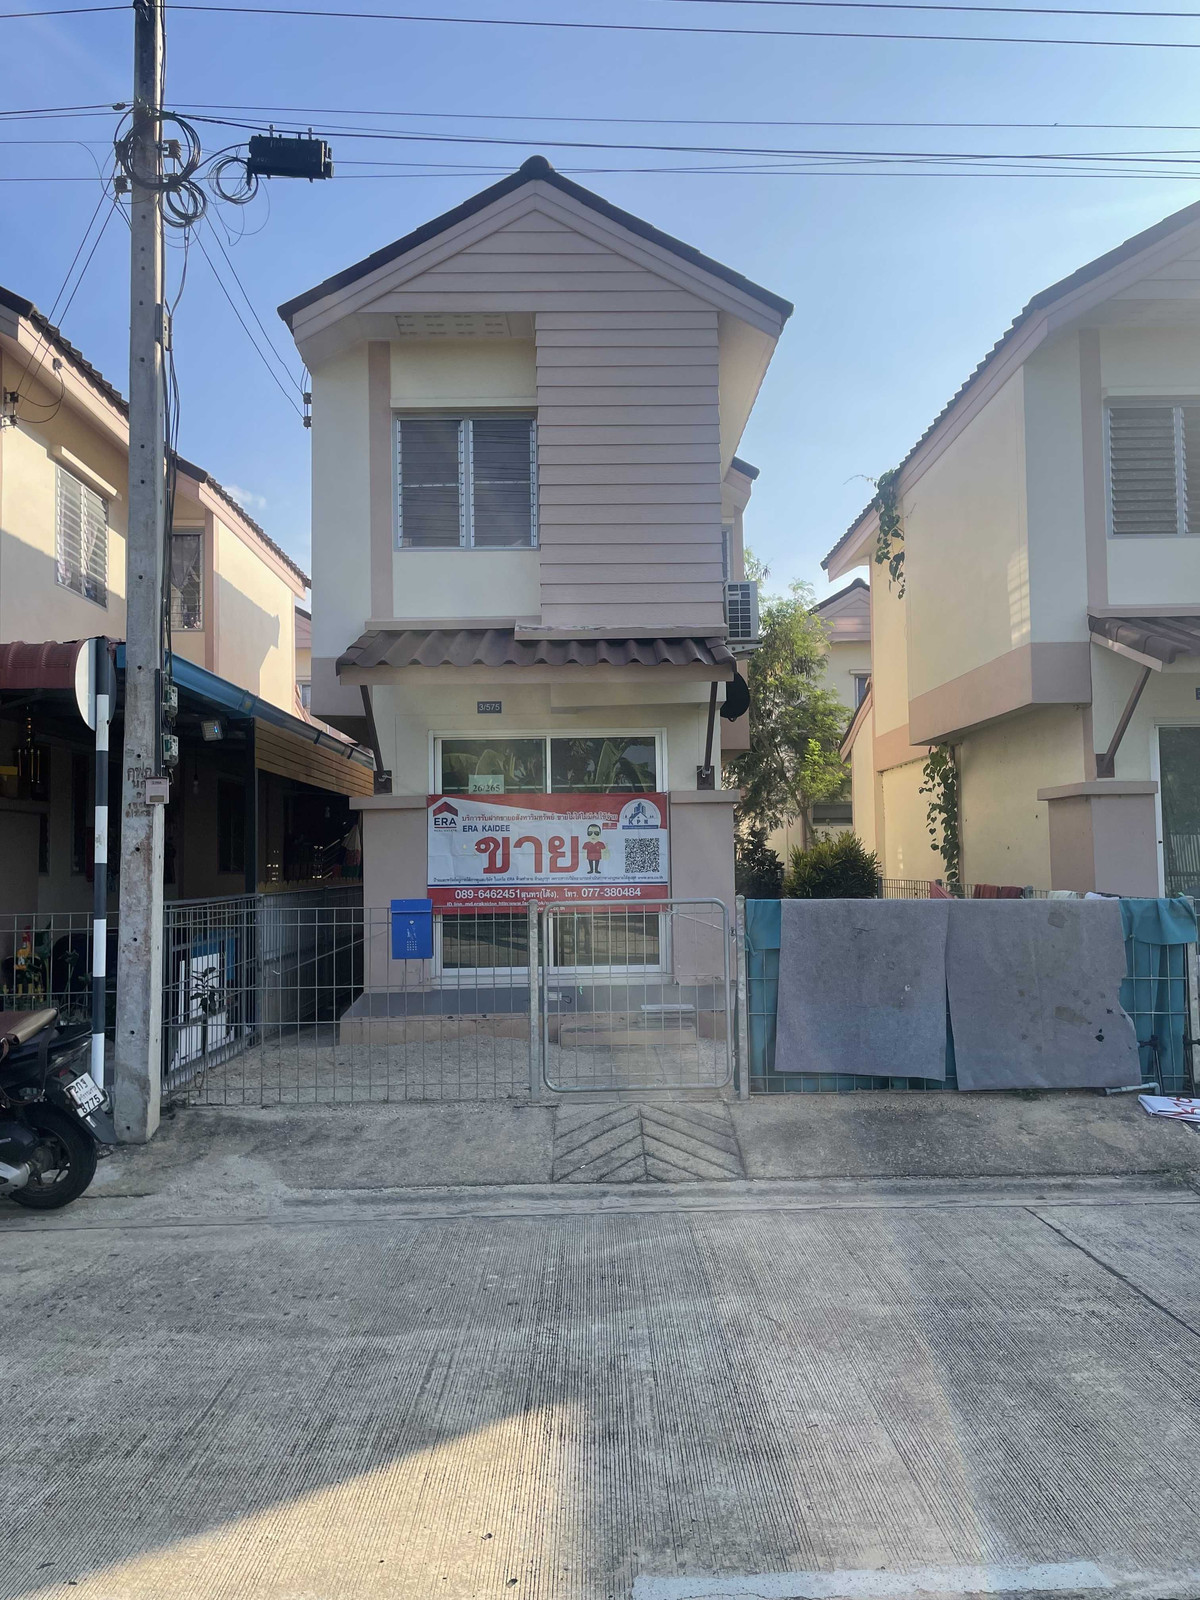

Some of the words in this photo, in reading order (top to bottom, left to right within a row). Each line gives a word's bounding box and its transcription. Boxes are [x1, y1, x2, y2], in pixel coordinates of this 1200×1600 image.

[479, 703, 500, 711] 3/575
[472, 784, 501, 793] 26/265
[434, 817, 457, 826] ERA
[462, 824, 478, 833] ERA
[482, 824, 511, 832] KAIDEE
[475, 835, 580, 874] ขาย
[455, 889, 520, 899] 089-6462451
[581, 887, 642, 898] 077-380484
[80, 1094, 101, 1113] 8775
